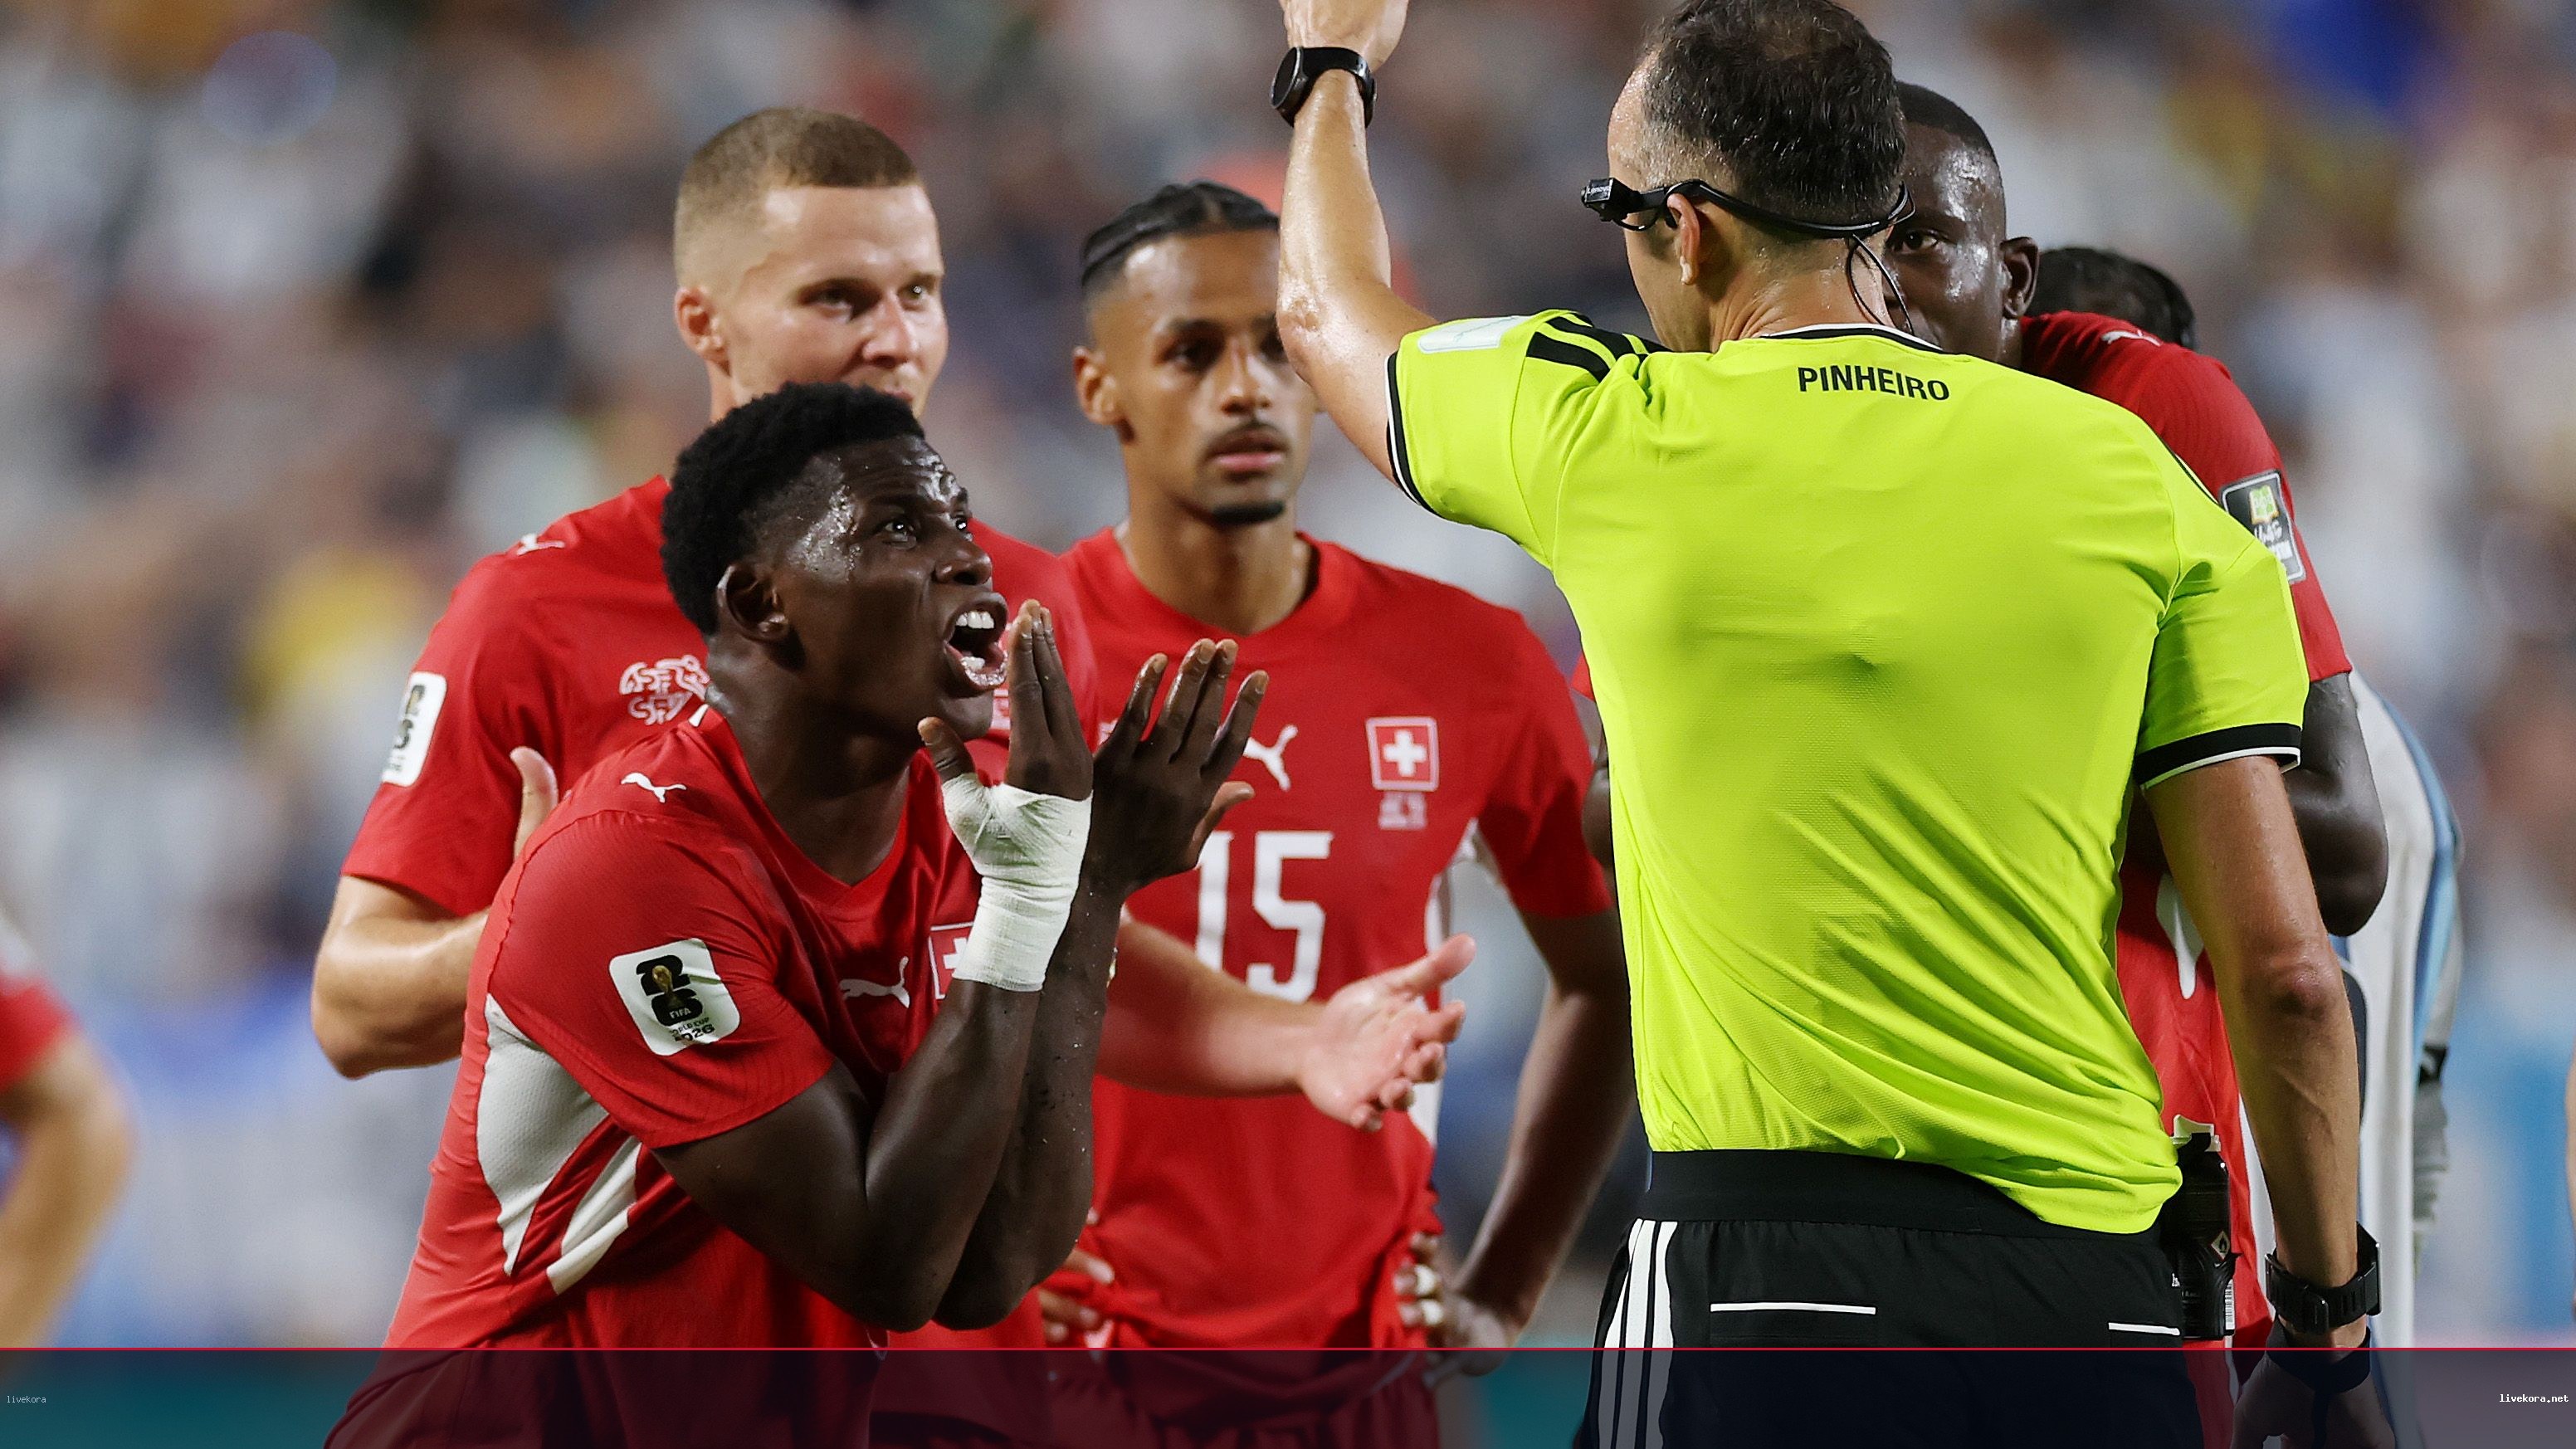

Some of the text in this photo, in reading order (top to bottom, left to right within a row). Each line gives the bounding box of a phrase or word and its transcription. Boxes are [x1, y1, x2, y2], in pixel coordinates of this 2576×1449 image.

[1798, 364, 1949, 401] PINHEIRO
[1195, 830, 1334, 1004] 15
[669, 1007, 691, 1019] FIFA
